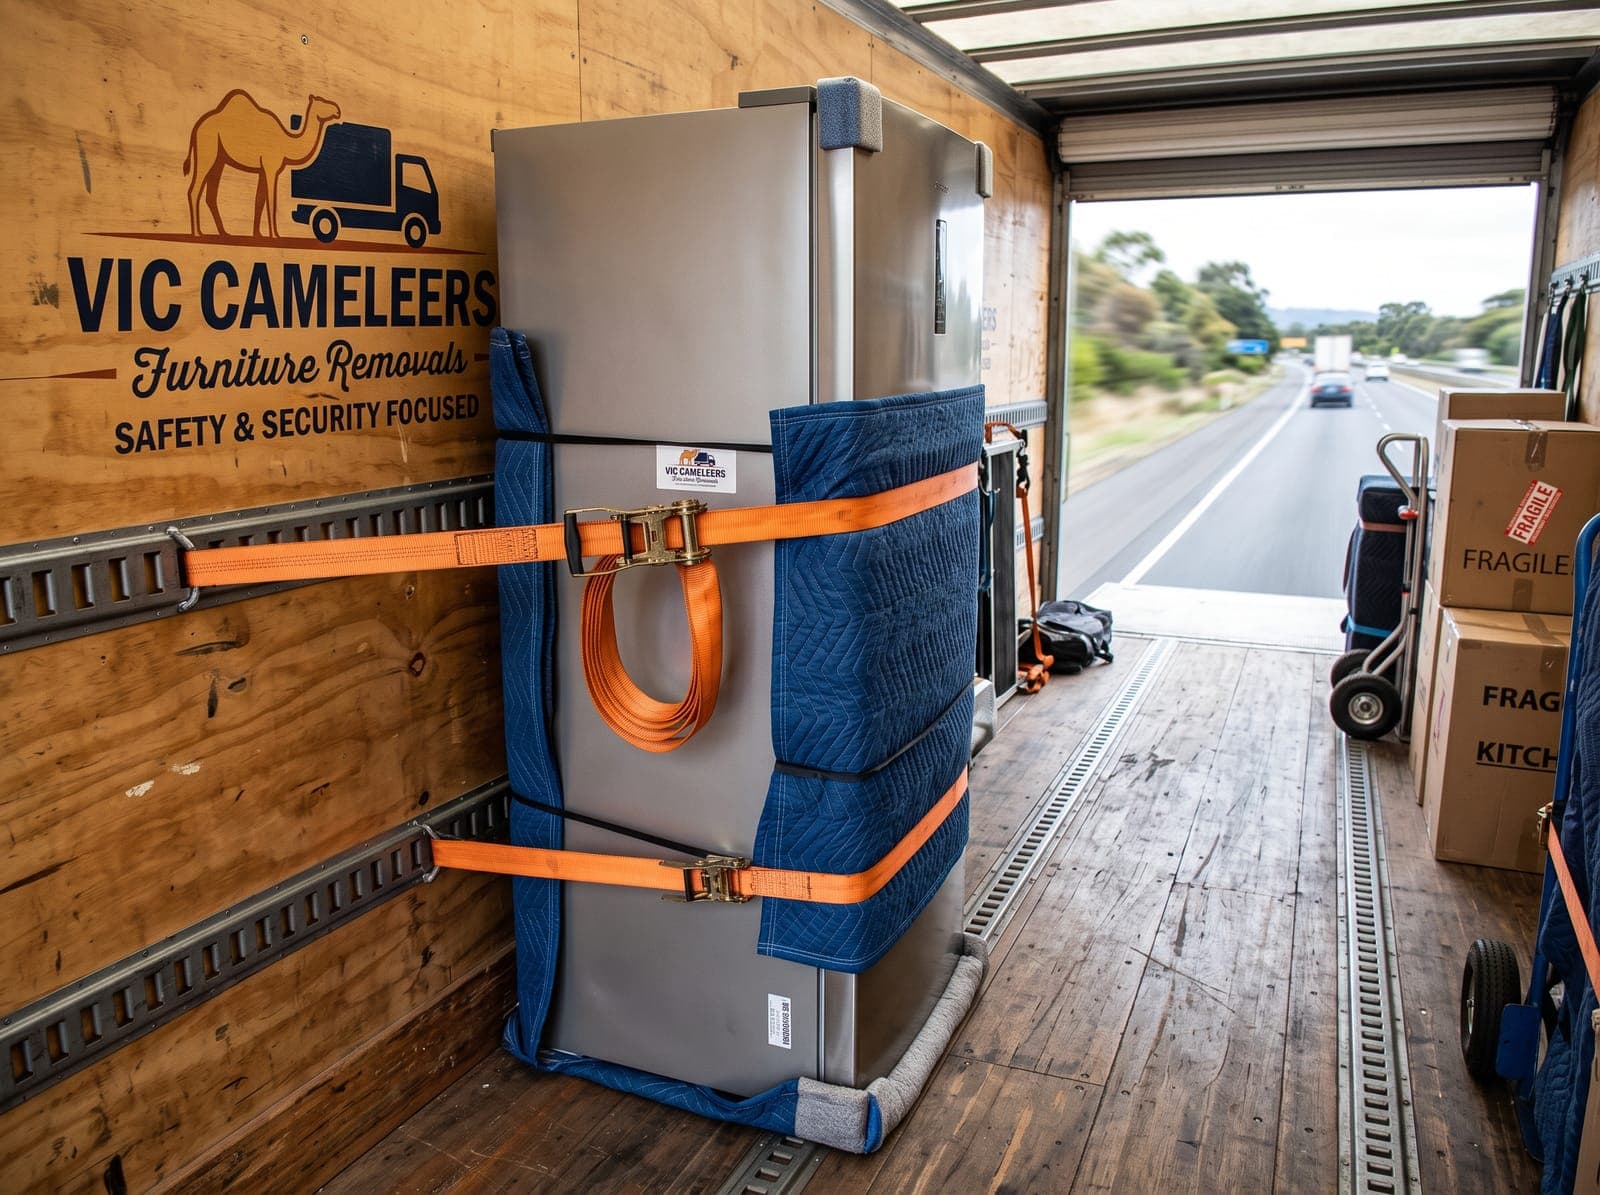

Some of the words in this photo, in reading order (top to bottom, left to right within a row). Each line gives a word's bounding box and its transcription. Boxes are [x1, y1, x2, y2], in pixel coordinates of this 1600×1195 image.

[67, 257, 182, 332] VIC
[200, 260, 497, 331] CAMELEERS
[132, 346, 320, 399] Furniture
[326, 339, 468, 393] Removals
[115, 413, 227, 455] SAFETY
[234, 411, 255, 443] &
[262, 400, 381, 440] SECURITY
[386, 393, 480, 433] FOCUSED
[665, 466, 679, 475] VIC
[679, 467, 726, 478] CAMELEERS
[1512, 485, 1553, 540] FRAGILE
[1463, 549, 1574, 577] FRAGILE
[1483, 685, 1564, 713] FRAG
